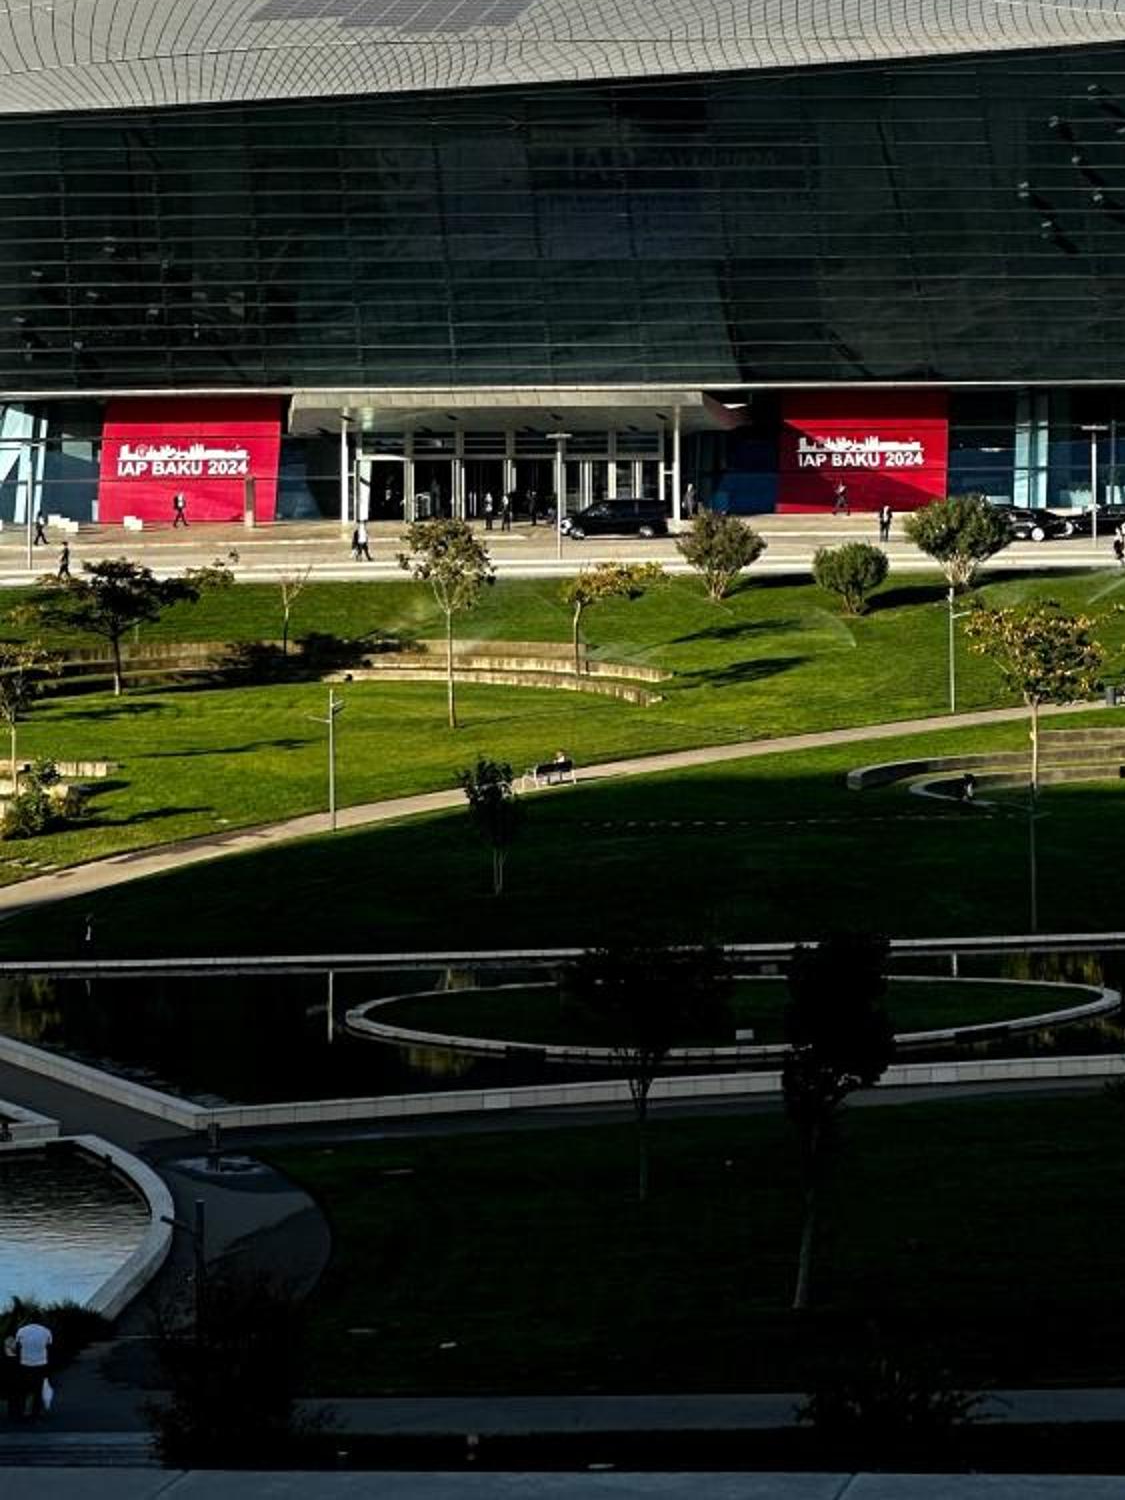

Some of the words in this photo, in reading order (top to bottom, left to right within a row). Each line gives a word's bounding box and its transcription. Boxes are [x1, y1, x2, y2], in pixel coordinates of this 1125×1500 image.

[799, 453, 827, 467] IAP
[832, 452, 880, 467] BAKU
[885, 451, 924, 466] 2024
[117, 461, 148, 476] IAP
[152, 461, 203, 476] BAKU
[207, 460, 248, 475] 2024
